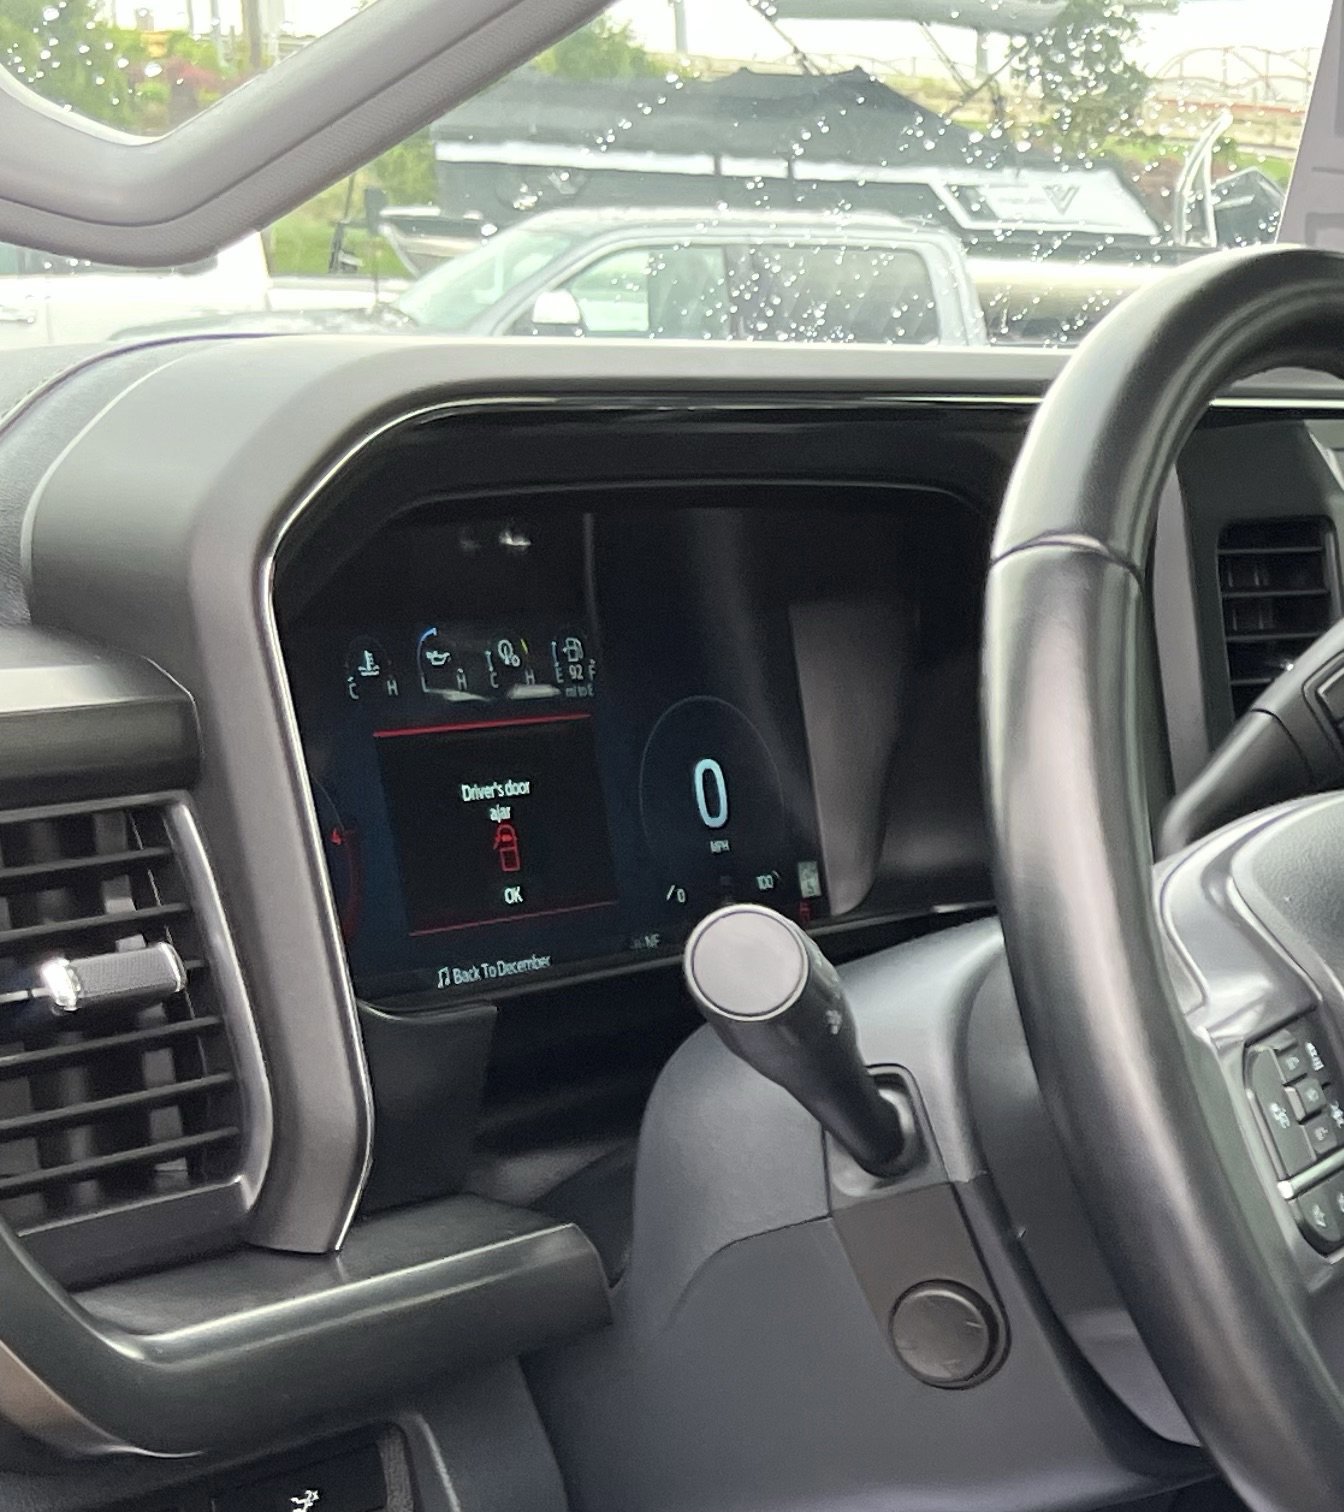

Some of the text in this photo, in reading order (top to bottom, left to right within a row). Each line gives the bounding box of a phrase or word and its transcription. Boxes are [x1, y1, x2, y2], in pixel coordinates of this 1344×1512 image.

[569, 664, 584, 680] 92
[461, 779, 530, 802] Driver's door
[694, 758, 729, 829] 0
[489, 803, 511, 823] ajar
[504, 886, 524, 904] OK
[452, 953, 552, 985] Back To December
